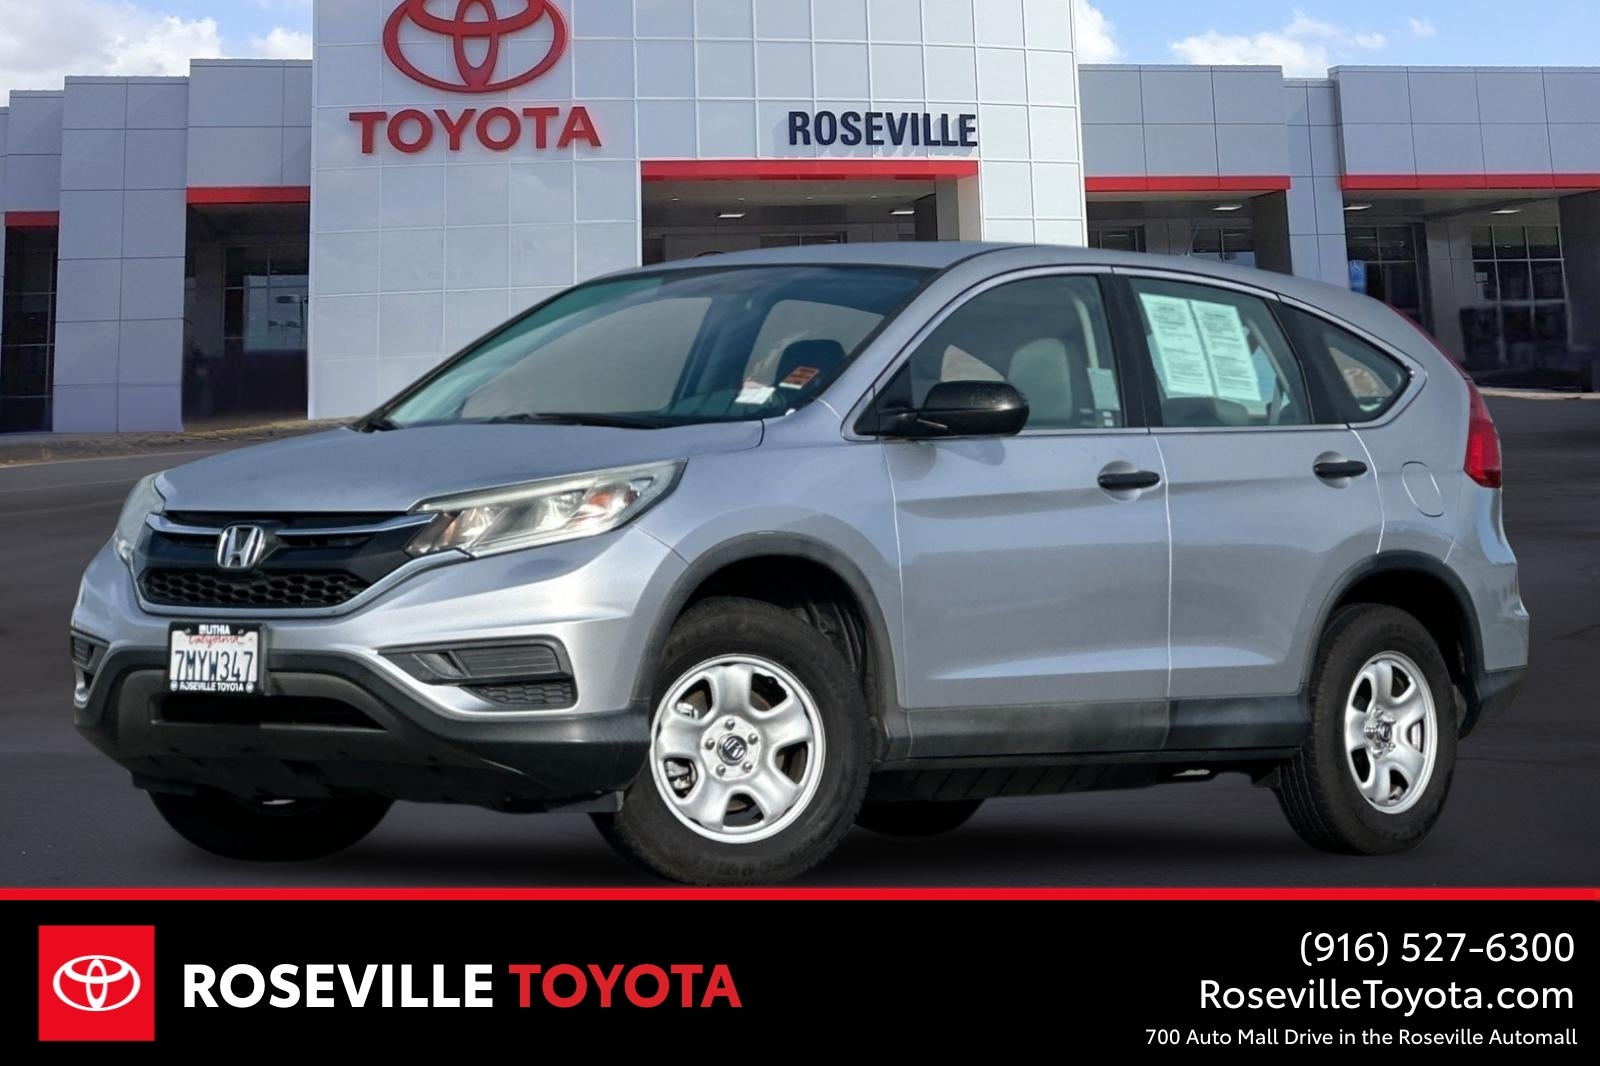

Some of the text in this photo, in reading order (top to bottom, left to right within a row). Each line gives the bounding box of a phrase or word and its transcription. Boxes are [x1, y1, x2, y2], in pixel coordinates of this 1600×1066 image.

[349, 106, 602, 154] TOYOTA
[788, 111, 978, 147] ROSEVILLE
[206, 624, 231, 635] LITHIA
[175, 650, 254, 681] 7MYW347
[179, 682, 244, 692] ROSEVILLE TOYOTA
